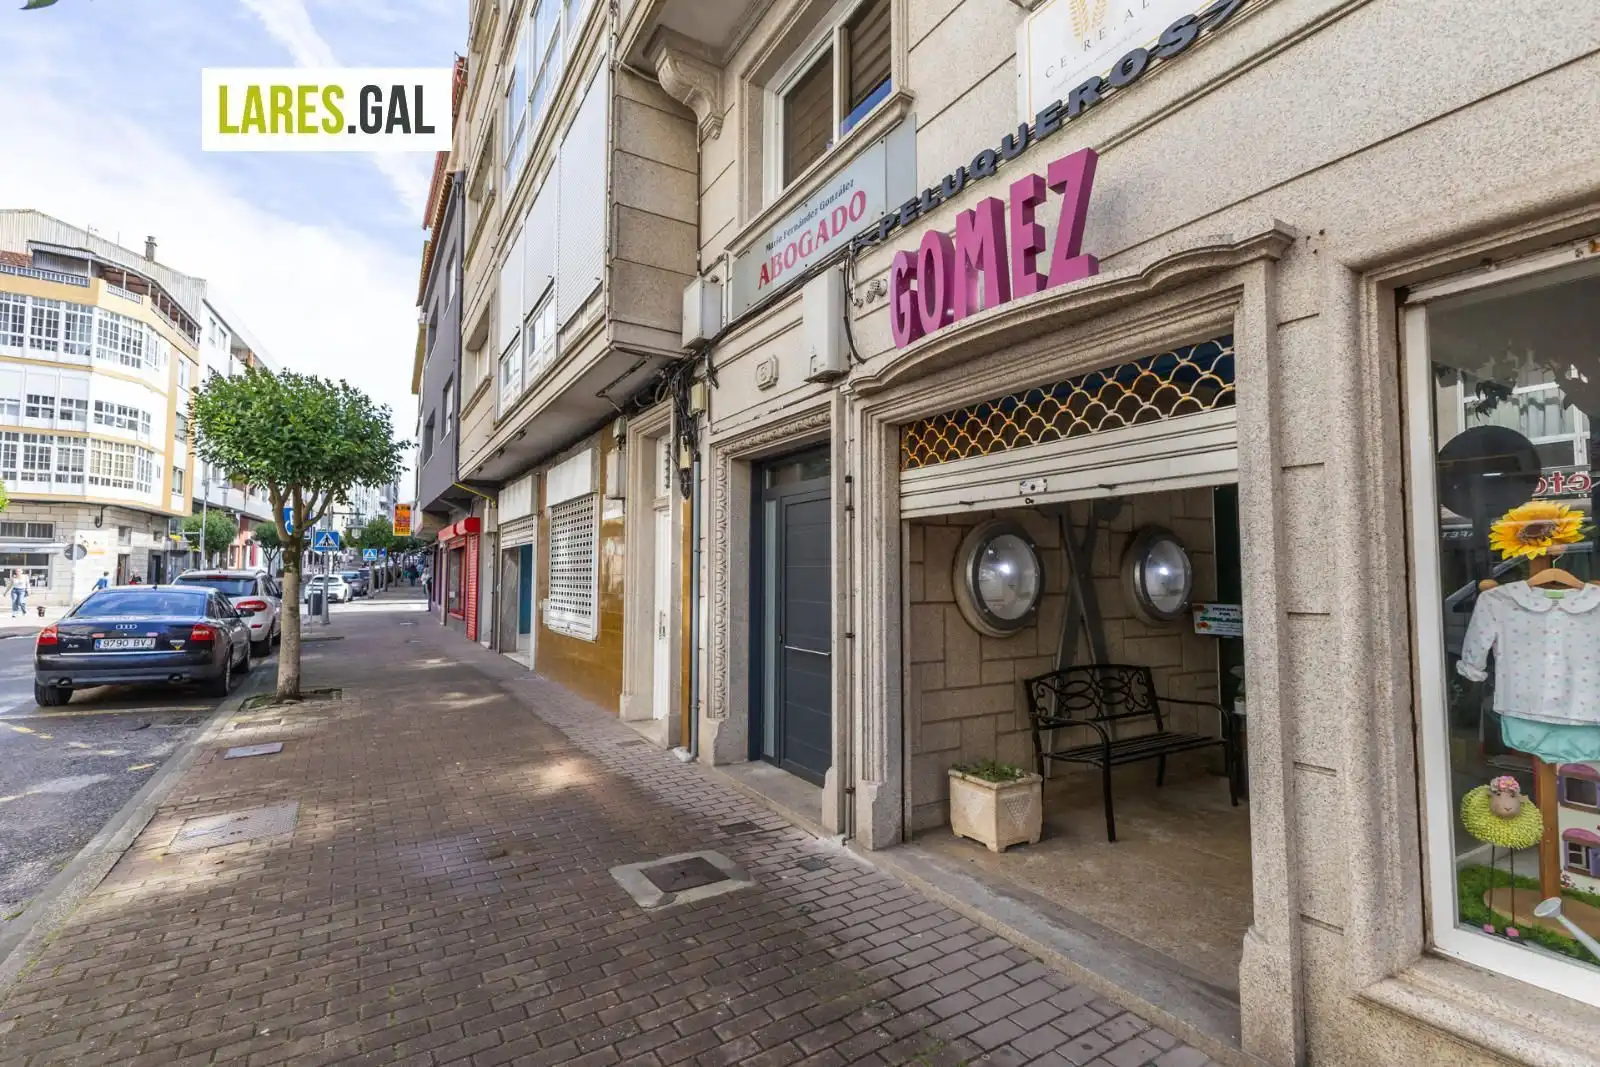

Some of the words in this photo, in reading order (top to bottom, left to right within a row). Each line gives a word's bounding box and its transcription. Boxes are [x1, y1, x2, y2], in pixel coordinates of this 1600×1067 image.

[878, 13, 1200, 241] PELUQUEROS
[757, 190, 867, 290] ABOGADO
[890, 147, 1100, 350] GOMEZ
[103, 639, 128, 647] 9790
